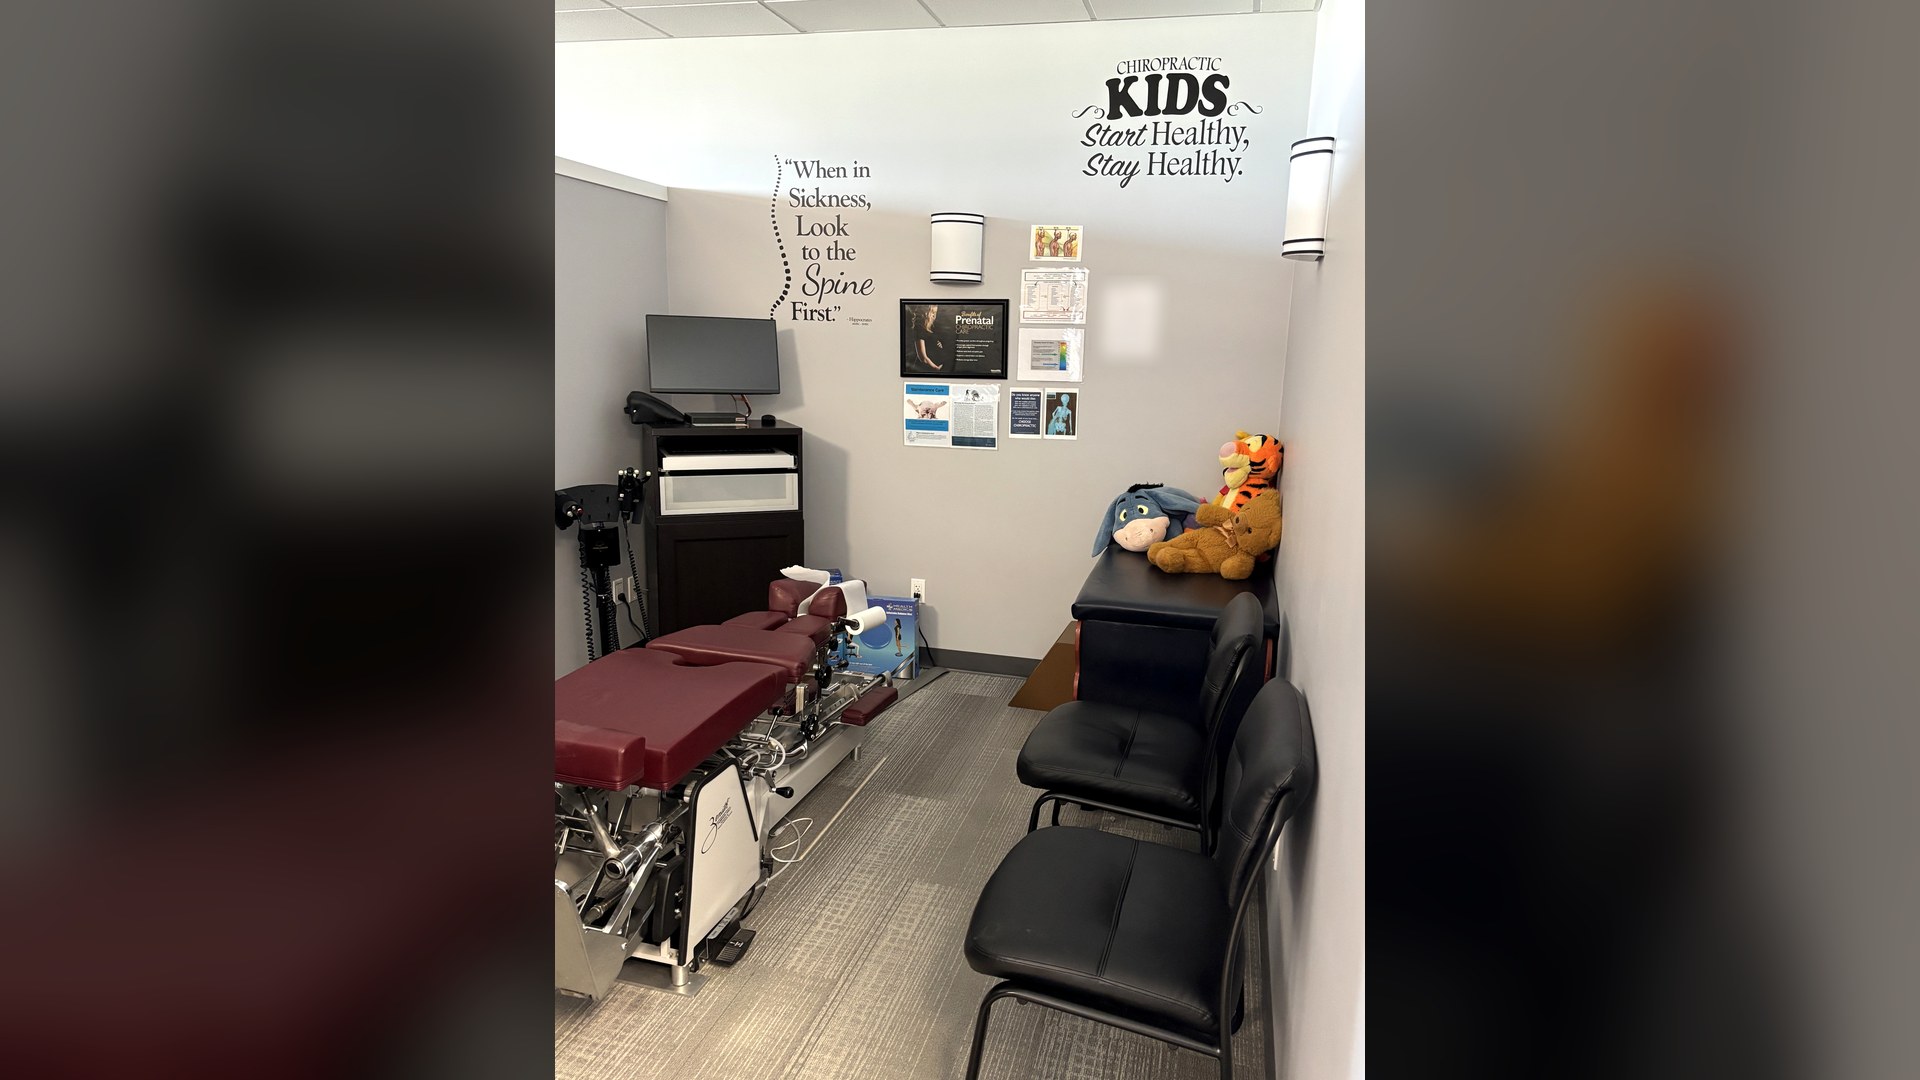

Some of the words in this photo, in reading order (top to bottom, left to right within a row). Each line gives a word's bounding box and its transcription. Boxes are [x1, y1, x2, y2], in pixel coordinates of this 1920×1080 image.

[1116, 56, 1222, 75] CHIROPRACTIC
[1105, 72, 1230, 120] KIDS
[1080, 122, 1149, 147] Start
[1150, 118, 1249, 152] Healthy,
[853, 160, 871, 178] in
[1082, 152, 1141, 188] Stay
[1146, 149, 1243, 183] Healthy.
[788, 187, 872, 211] Sickness,
[794, 214, 850, 237] Look
[801, 245, 820, 261] to
[826, 240, 856, 261] the
[801, 262, 876, 304] Spine
[955, 314, 994, 325] Prenatal
